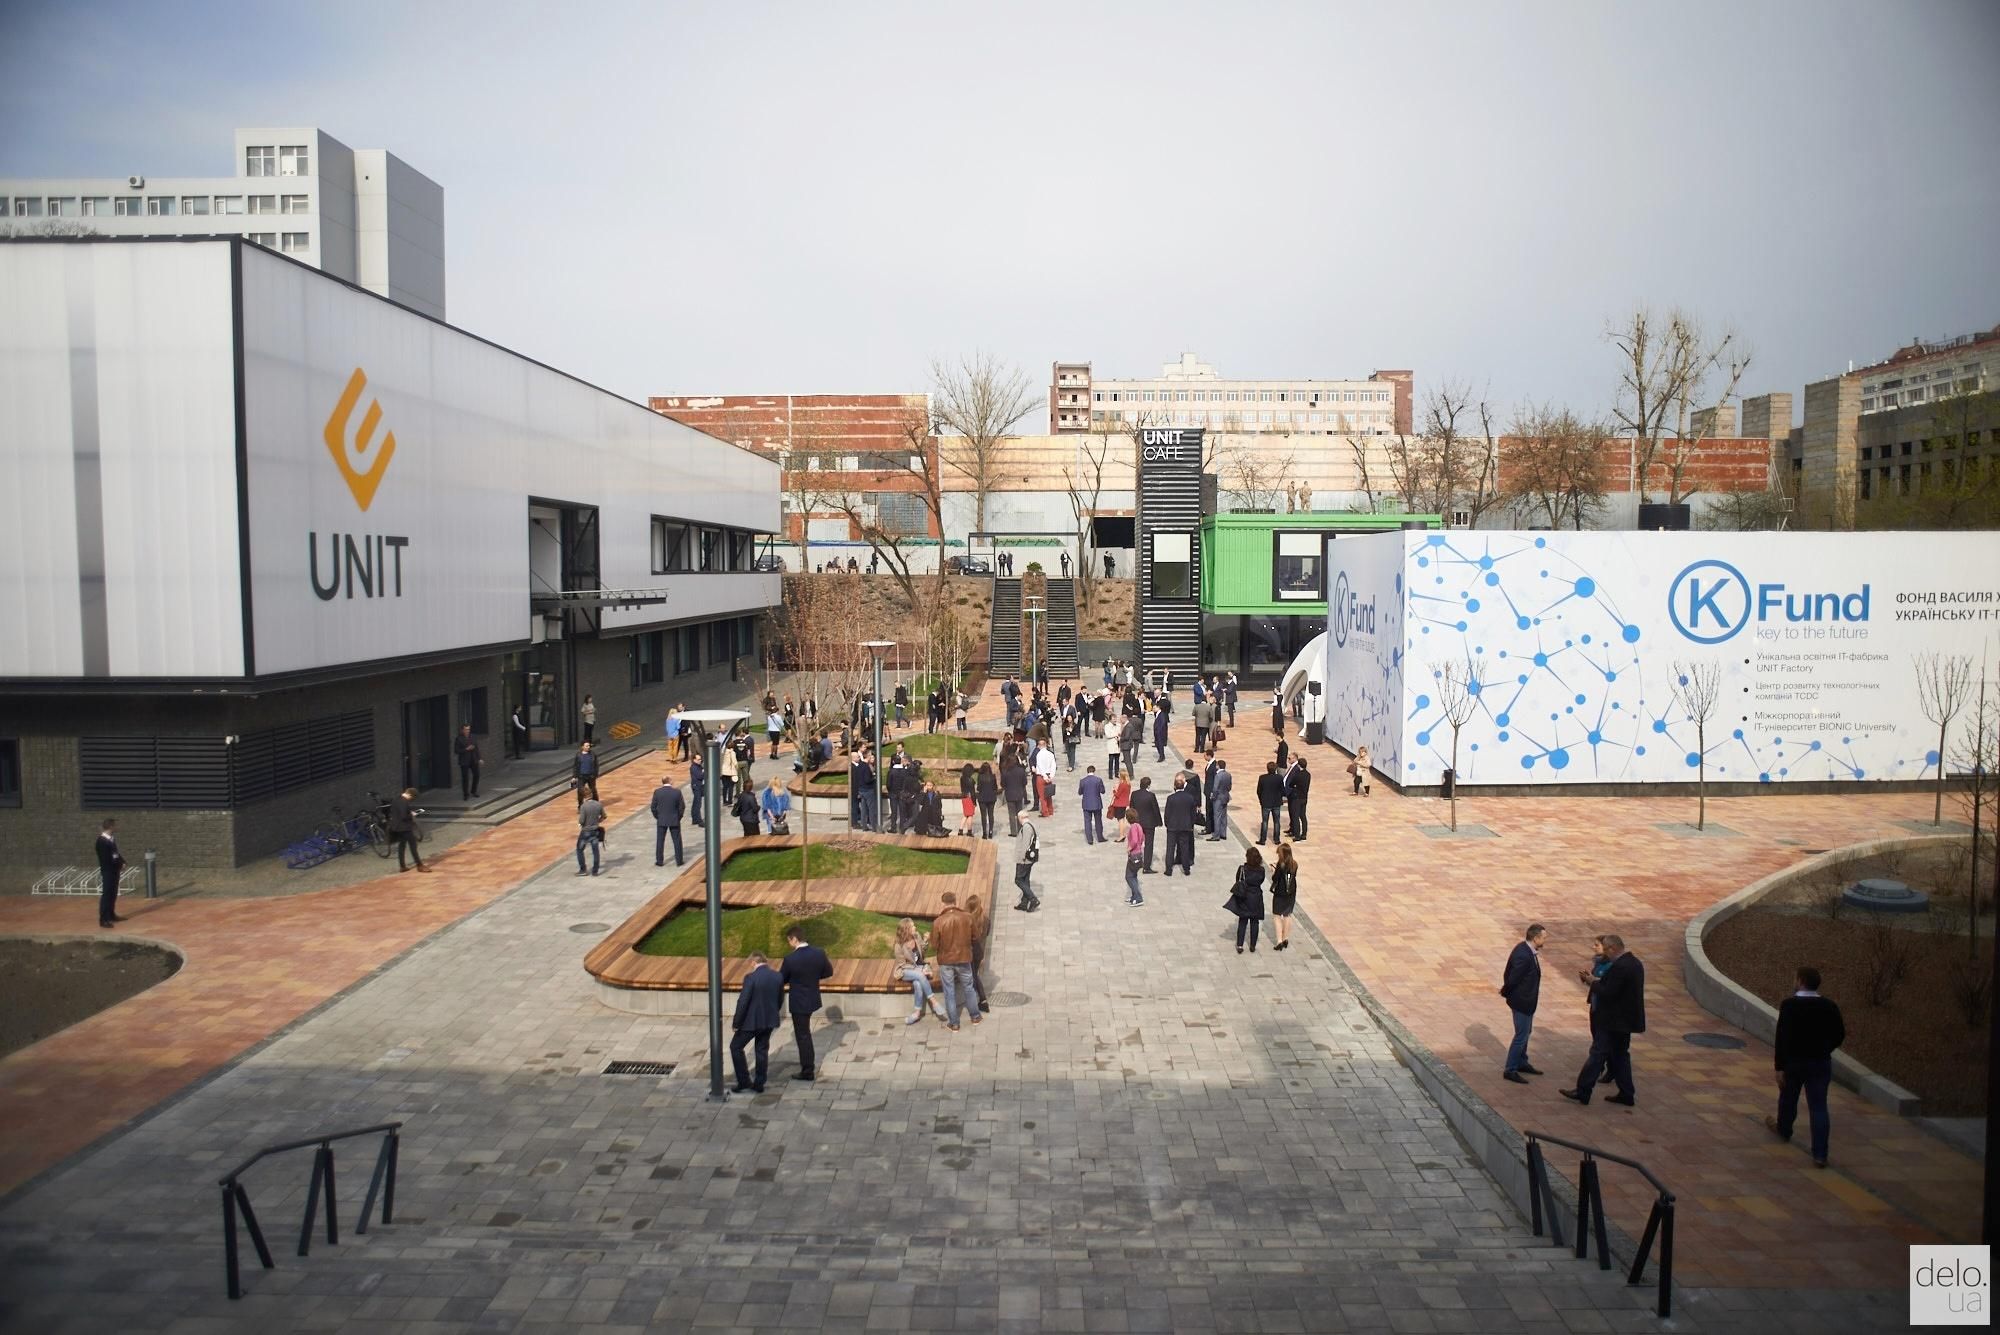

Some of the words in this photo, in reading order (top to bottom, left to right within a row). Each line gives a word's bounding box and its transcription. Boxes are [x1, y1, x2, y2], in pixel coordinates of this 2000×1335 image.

[1143, 430, 1184, 445] UNIT
[1143, 446, 1184, 461] CAFE
[309, 532, 409, 601] UNIT
[1757, 583, 1871, 622] Fund
[1896, 592, 1937, 605] ФОНД
[1940, 592, 1993, 603] ВАСИЛЯ
[1350, 592, 1376, 635] Fund
[1896, 607, 1976, 621] УКРАЇНСЬКУ
[1756, 626, 1781, 642] key
[1785, 627, 1799, 639] to
[1803, 626, 1826, 640] the
[1829, 625, 1869, 640] future
[1756, 664, 1778, 673] UNIT
[1780, 664, 1814, 674] Factory
[1819, 722, 1852, 732] BIONIC
[1854, 722, 1897, 733] University
